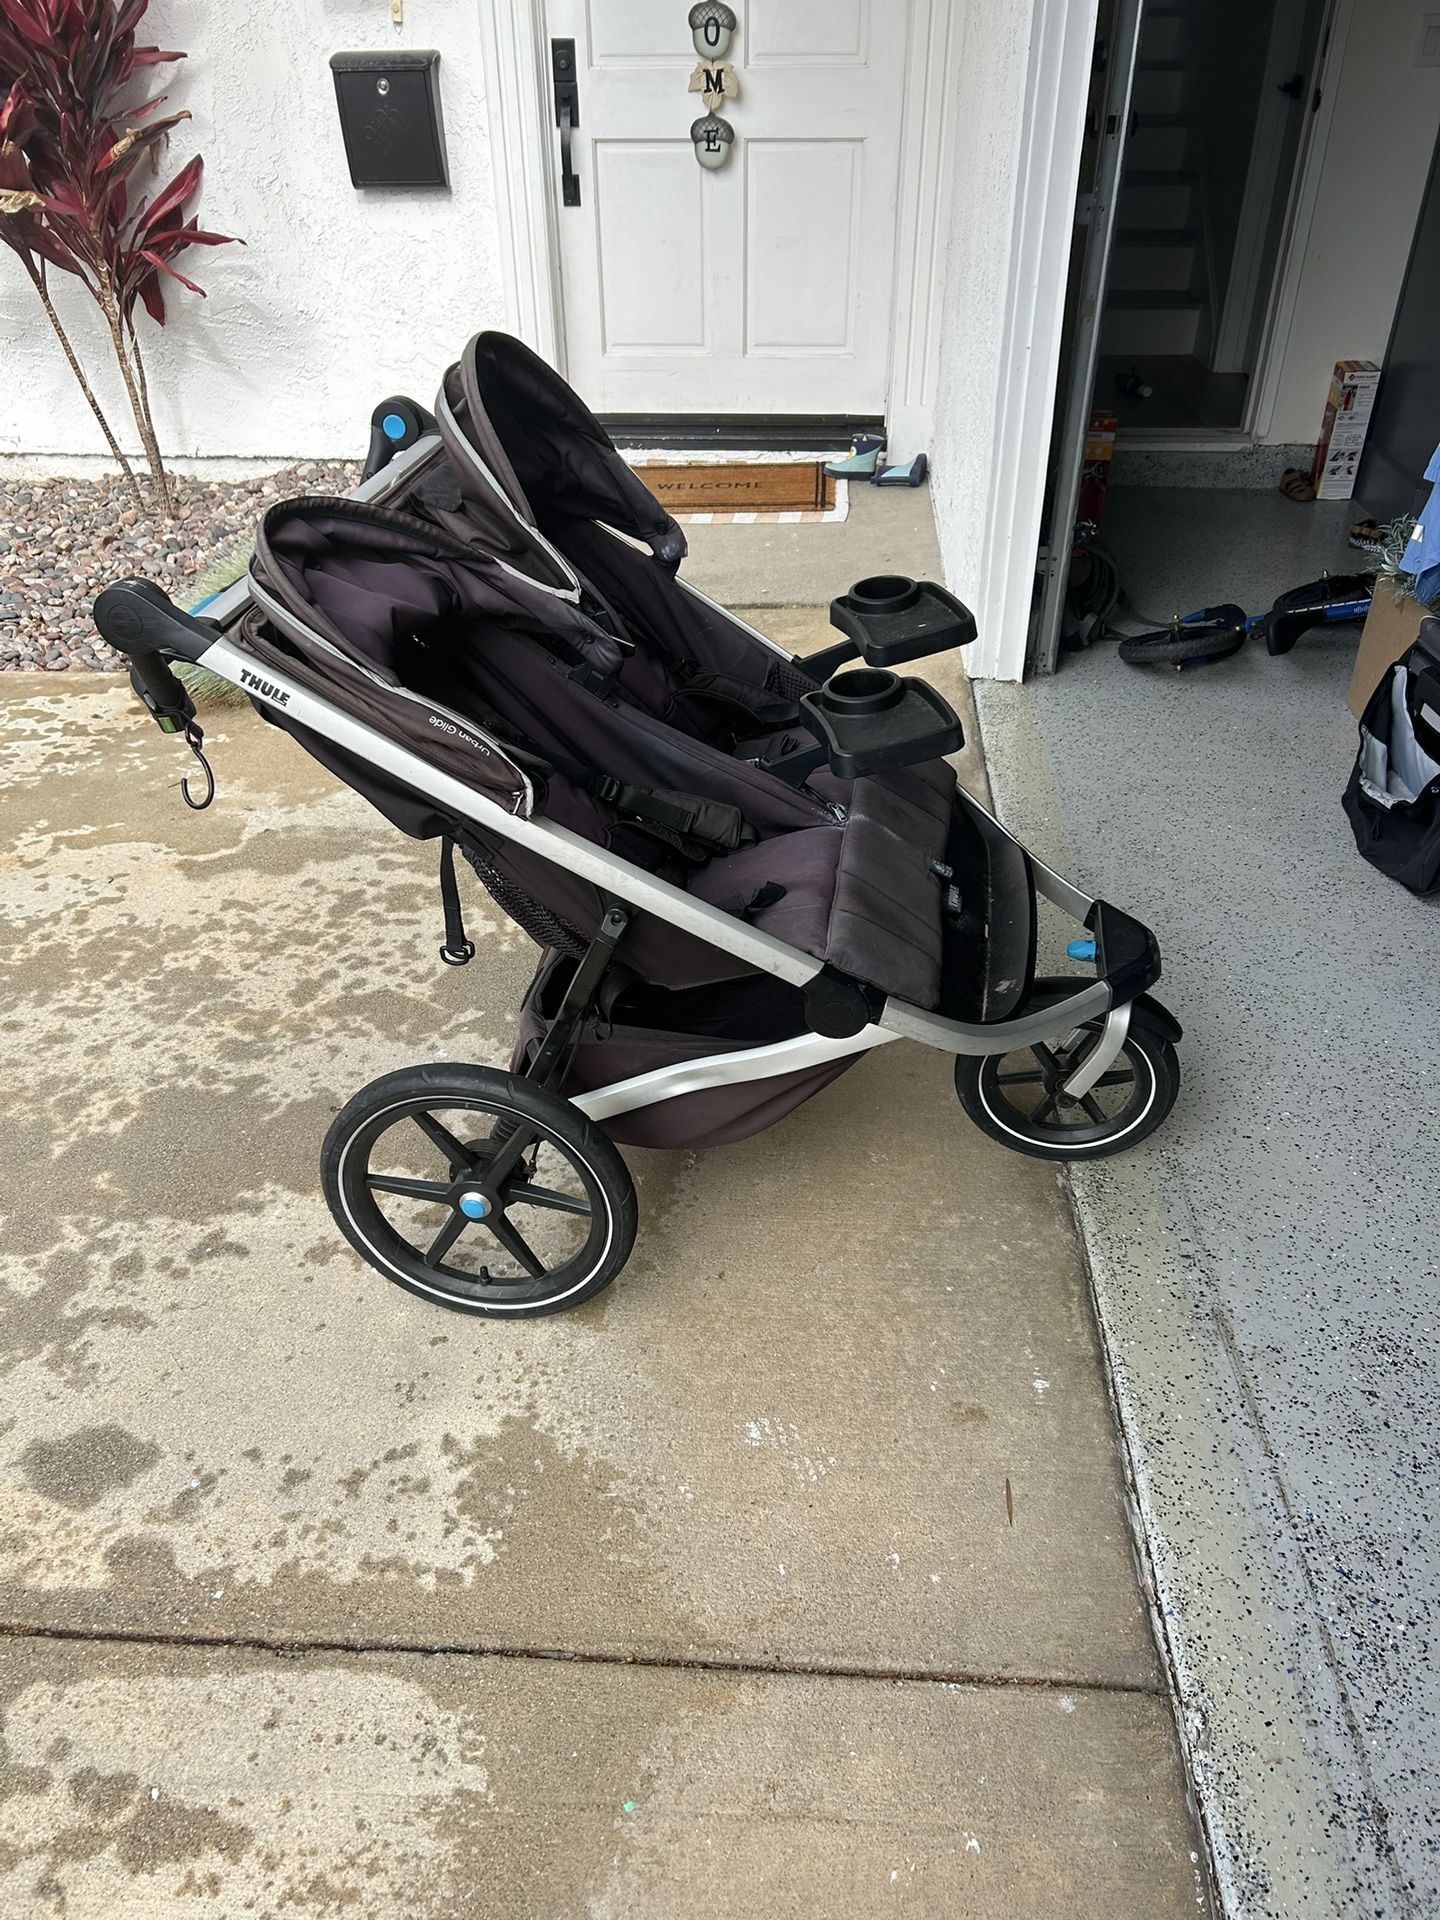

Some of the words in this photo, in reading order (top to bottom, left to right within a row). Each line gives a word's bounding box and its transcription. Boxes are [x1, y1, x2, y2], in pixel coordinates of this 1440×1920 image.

[657, 481, 762, 490] WELCOME
[240, 668, 291, 707] THULE
[428, 715, 457, 735] Glide
[458, 730, 491, 757] Urban
